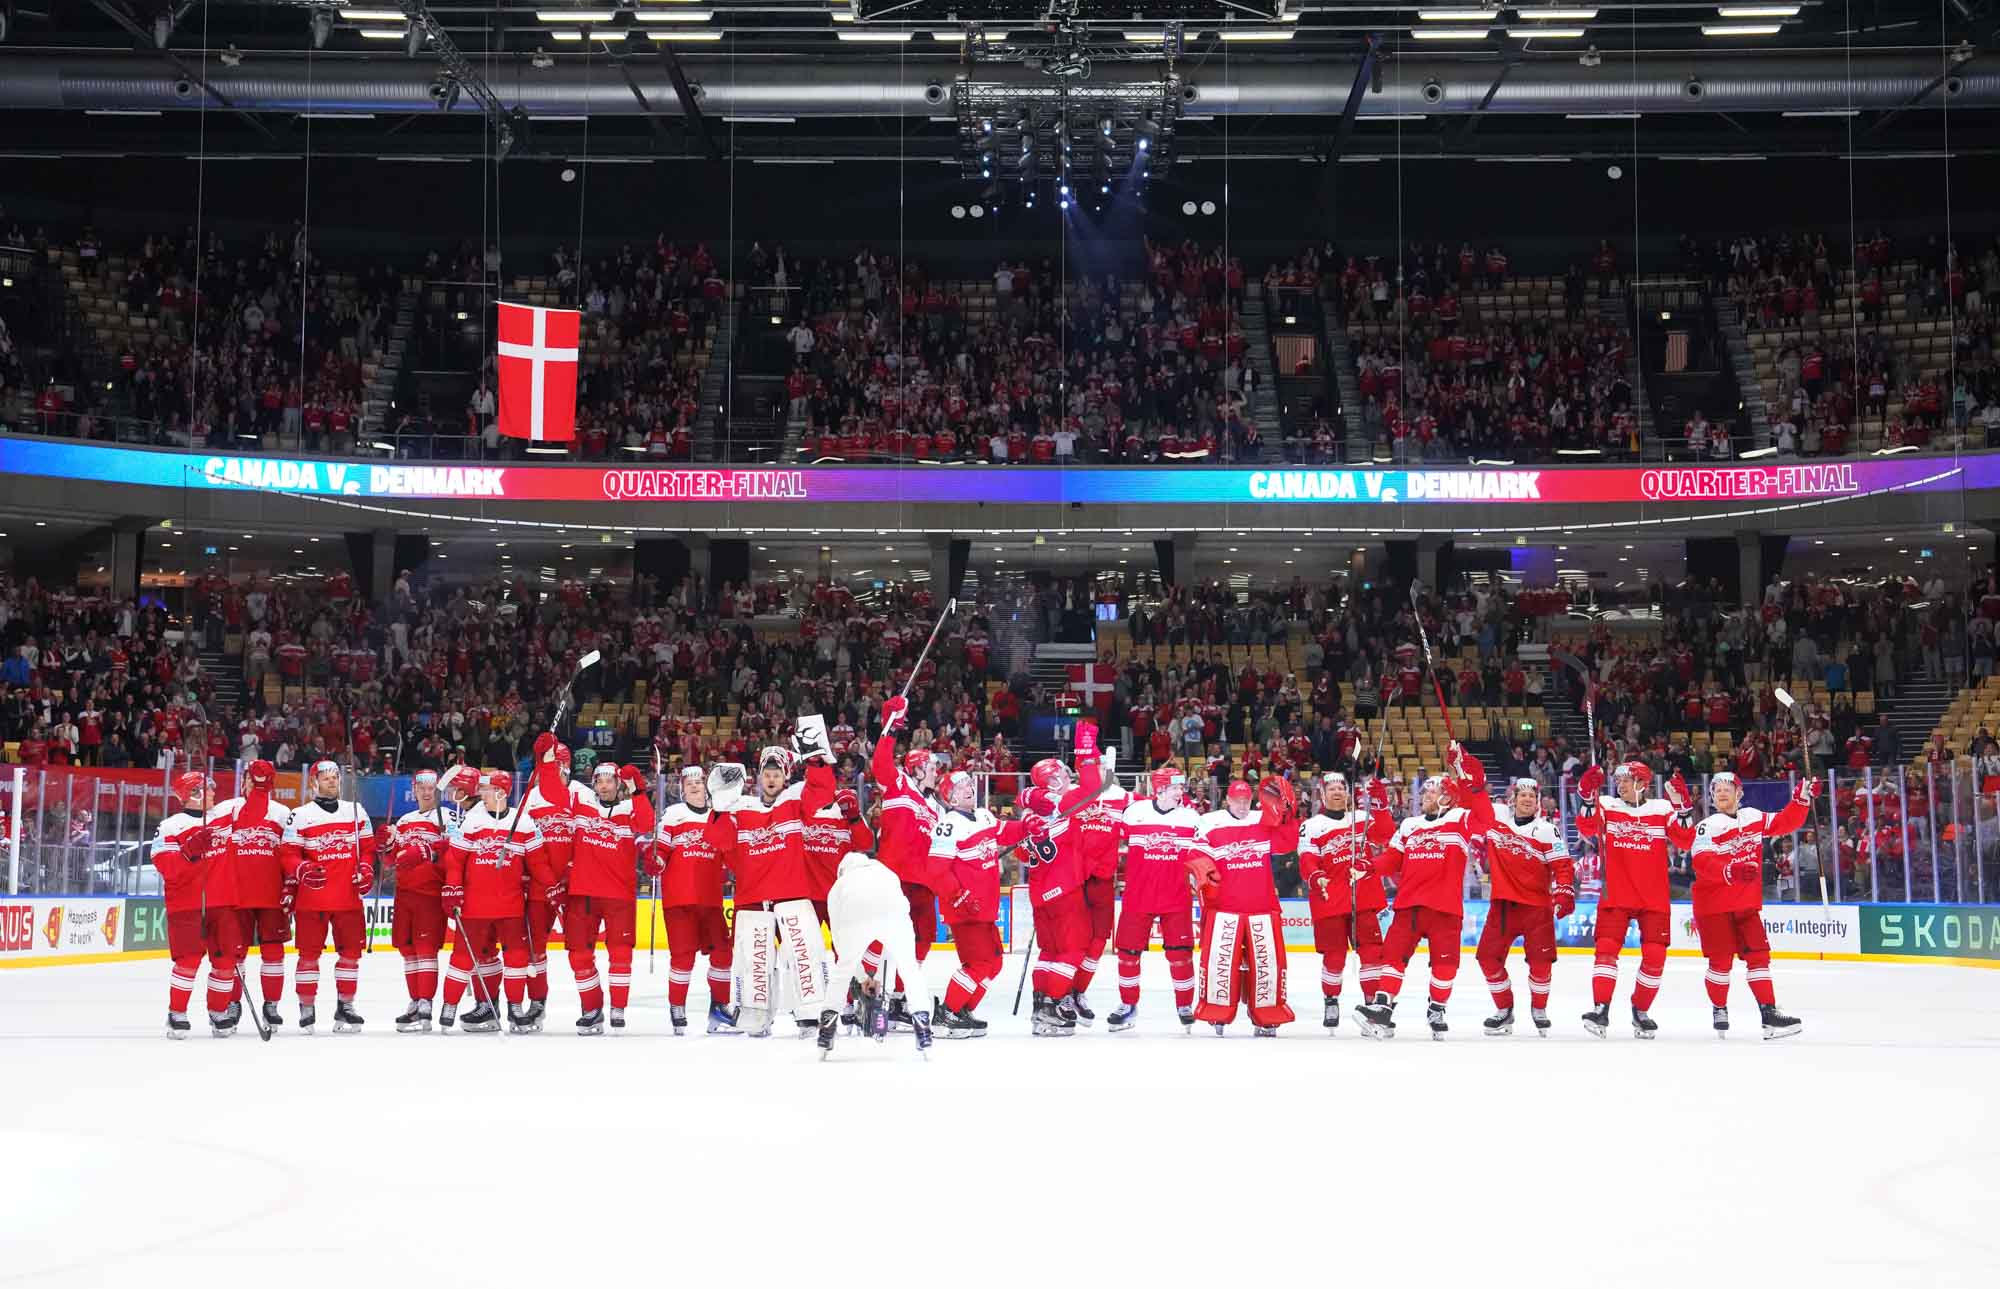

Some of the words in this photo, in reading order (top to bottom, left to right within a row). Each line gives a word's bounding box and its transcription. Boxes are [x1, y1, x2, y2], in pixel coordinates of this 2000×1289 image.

[204, 458, 318, 489] CANADA
[370, 469, 505, 496] DENMARK
[1641, 465, 1858, 499] QUARTER-FINAL
[603, 471, 807, 499] QUARTER-FINAL
[1250, 471, 1357, 499] CANADA
[1407, 472, 1540, 499] DENMARK
[935, 823, 954, 837] 63
[1696, 823, 1706, 836] 6
[582, 836, 617, 849] DANMARK
[1613, 840, 1651, 851] DANMARK
[749, 844, 786, 856] DANMARK
[1143, 853, 1178, 861] DANMARK
[1408, 852, 1445, 860] DANMARK
[318, 853, 352, 862] DANMARK
[1332, 852, 1367, 865] DANMK
[1226, 861, 1263, 870] DANMARK
[67, 909, 98, 928] Happiness
[1280, 918, 1313, 927] BOSC
[69, 932, 77, 944] at
[78, 931, 93, 945] work
[786, 915, 815, 998] DANMARK
[1216, 920, 1237, 1001] DANMARK
[1252, 921, 1269, 1002] DANMARK
[753, 927, 768, 1004] DANMARK
